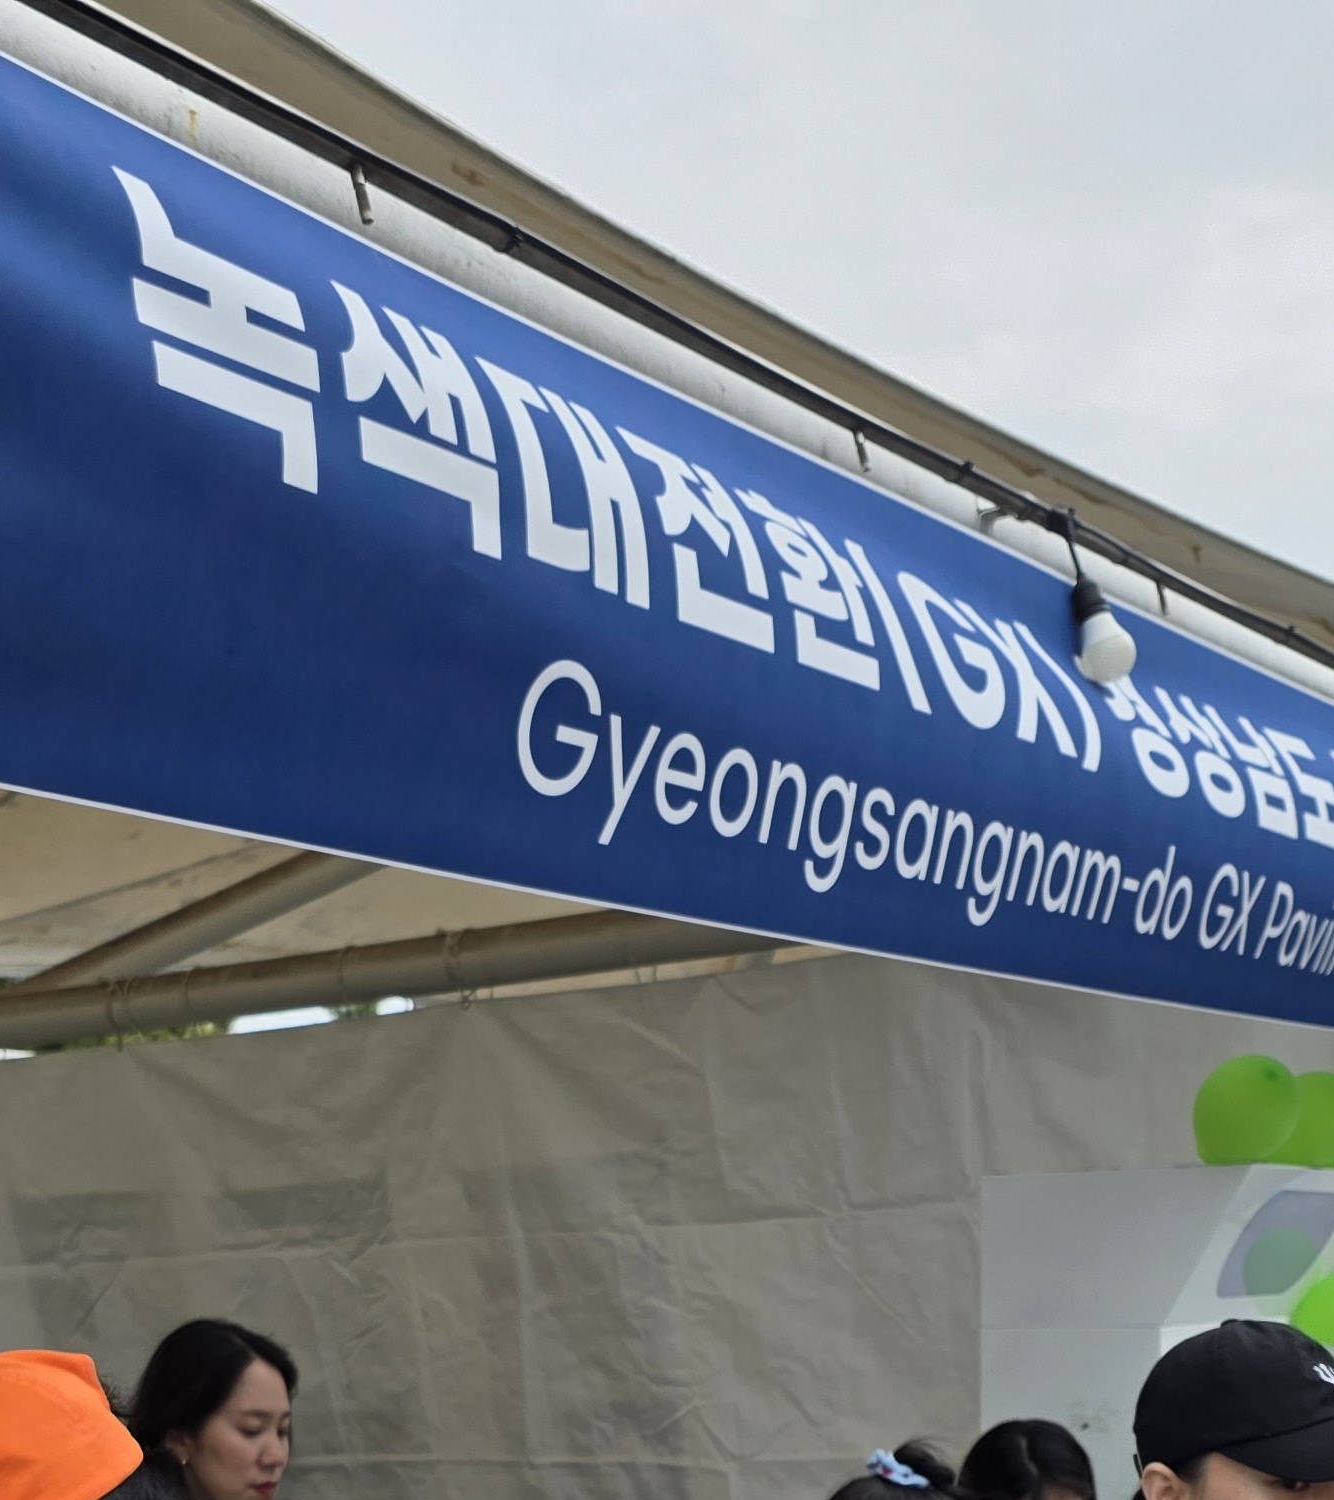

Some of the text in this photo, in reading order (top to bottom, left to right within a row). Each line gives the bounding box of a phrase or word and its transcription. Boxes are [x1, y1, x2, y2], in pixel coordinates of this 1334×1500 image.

[111, 166, 1100, 772] 녹색대전환(GX)
[517, 659, 1194, 927] Gyeongsangnam-do
[1198, 862, 1257, 960] GX
